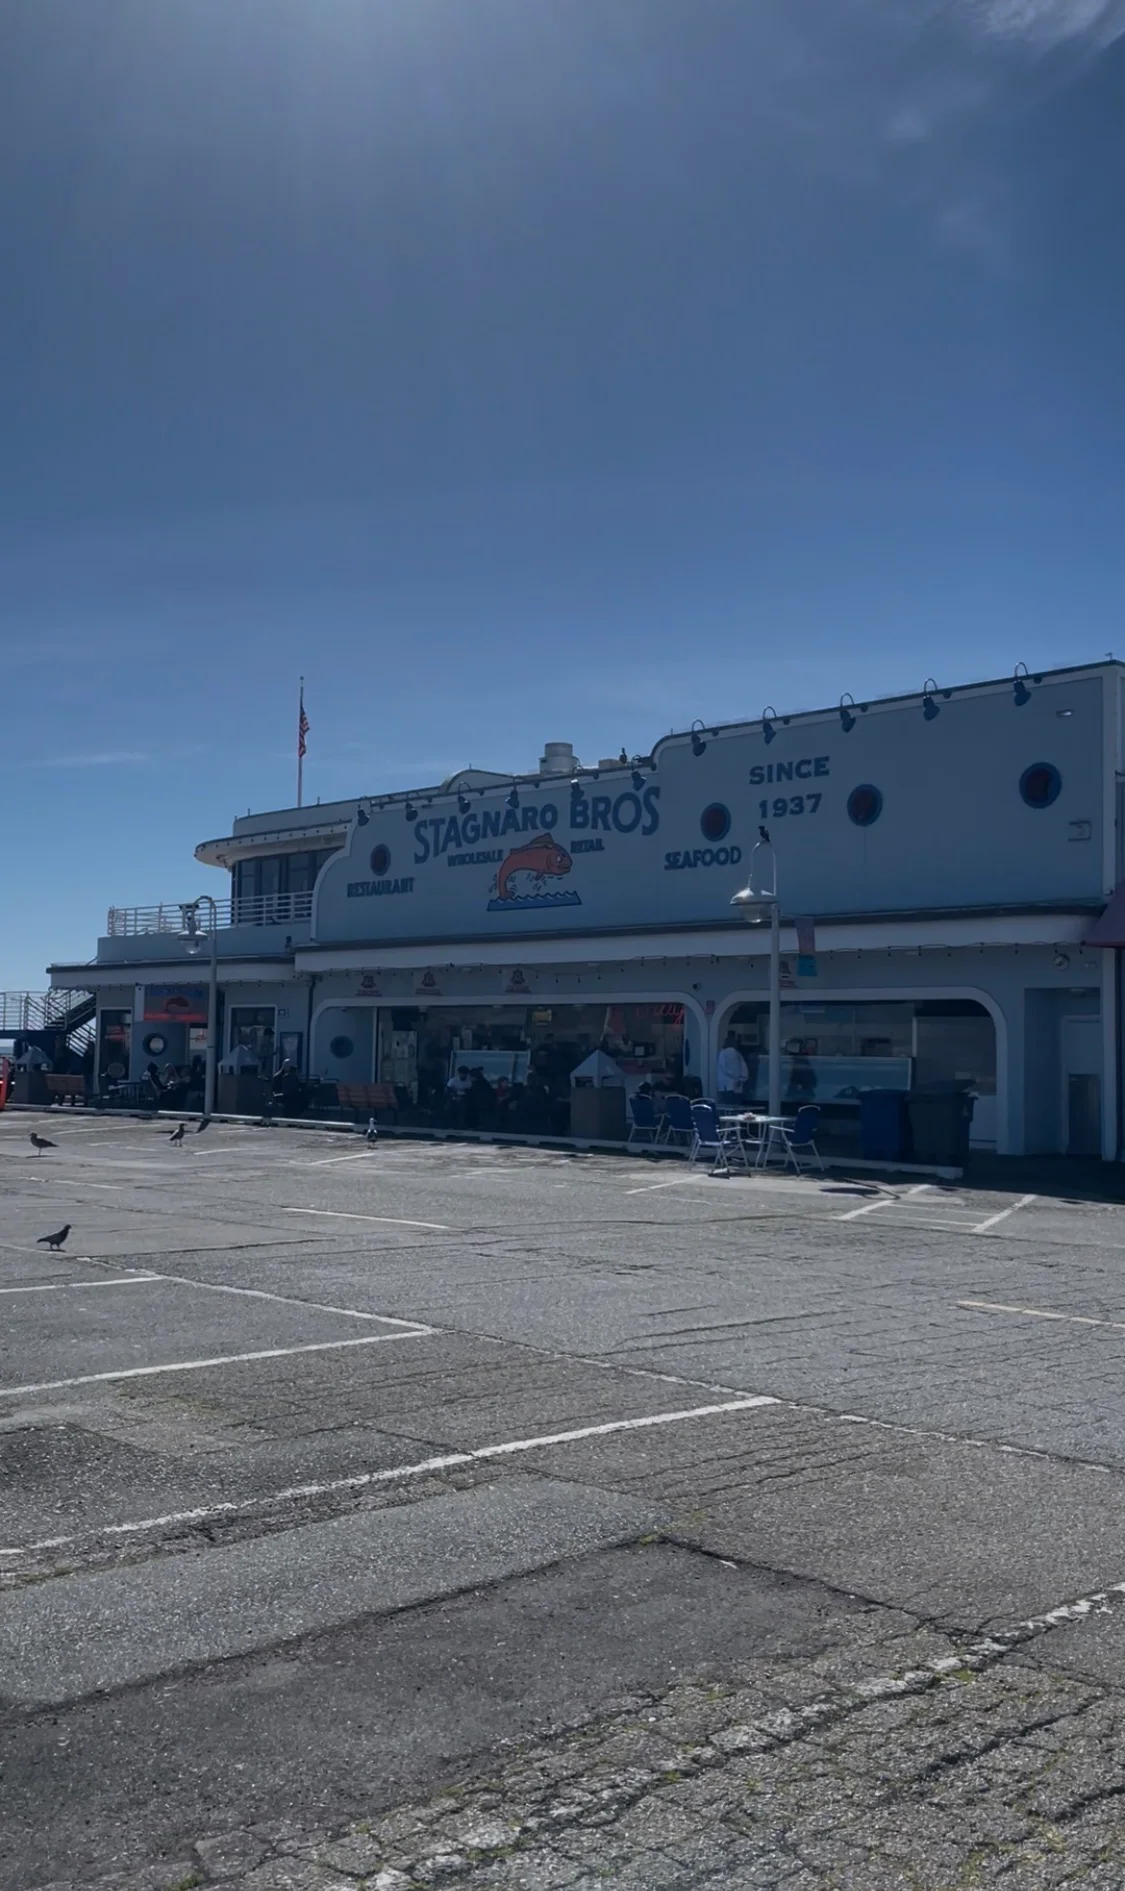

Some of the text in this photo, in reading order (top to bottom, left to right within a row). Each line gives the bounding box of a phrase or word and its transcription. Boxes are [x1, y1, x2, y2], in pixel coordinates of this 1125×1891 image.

[749, 756, 831, 785] SINCE
[758, 793, 823, 820] 1937
[413, 785, 661, 865] STAGNARO BROS
[447, 837, 605, 868] WHOLESALE RETAIL
[664, 845, 742, 870] SEAFOOD
[347, 876, 415, 898] RESTAURANT
